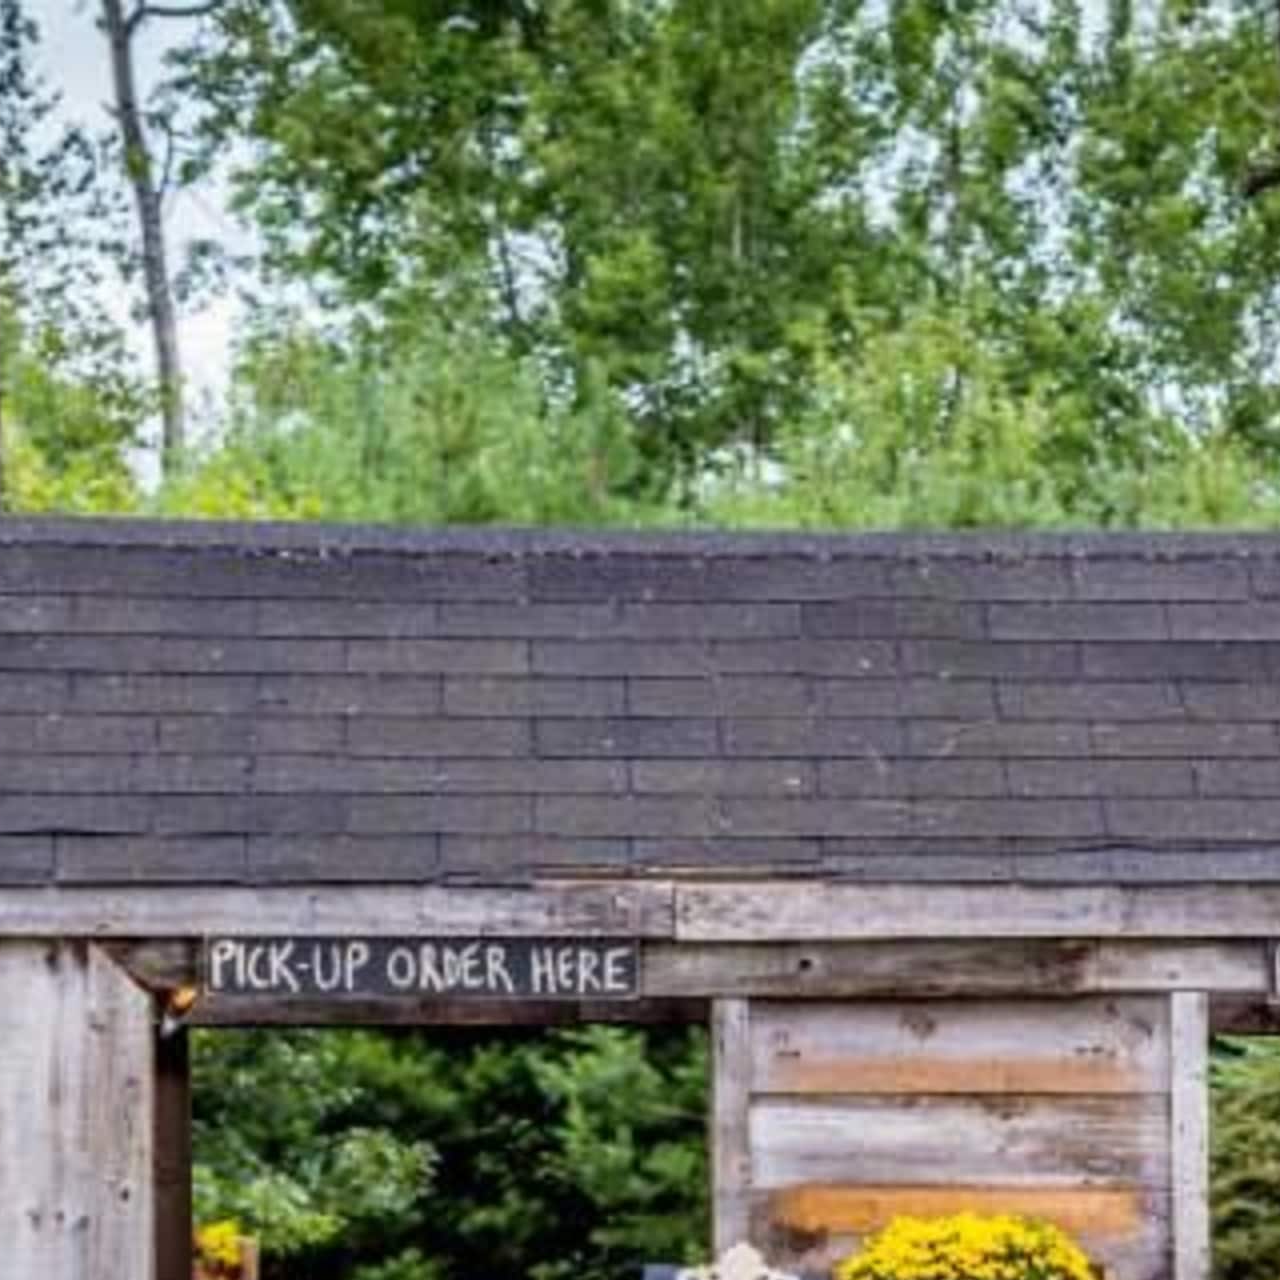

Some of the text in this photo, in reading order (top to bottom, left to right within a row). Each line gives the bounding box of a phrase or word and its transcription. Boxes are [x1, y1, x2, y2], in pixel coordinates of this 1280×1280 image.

[210, 940, 634, 995] PICK-UP ORDER HERE
